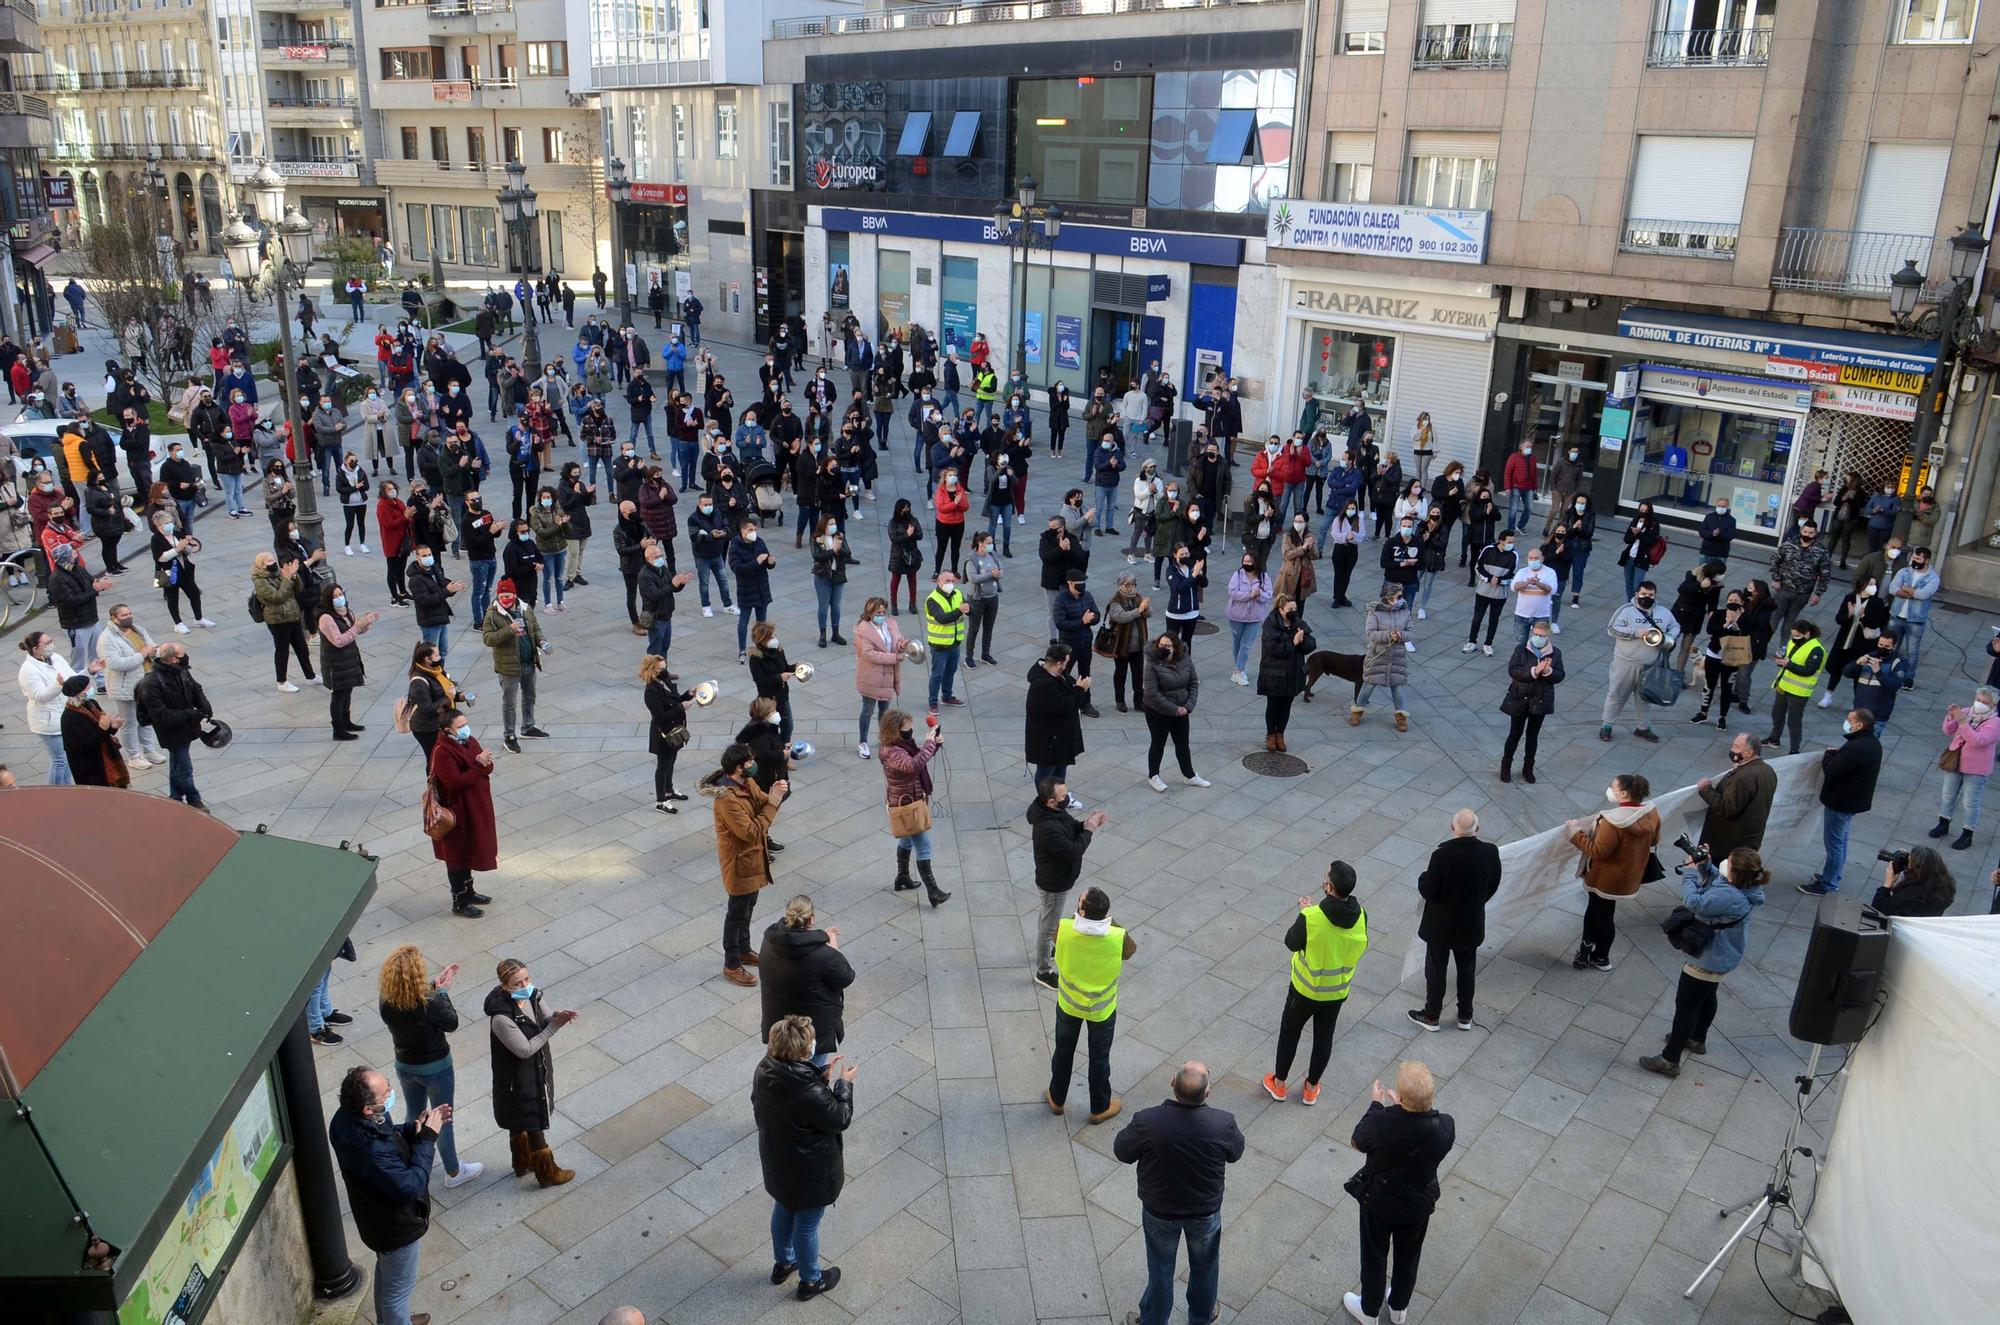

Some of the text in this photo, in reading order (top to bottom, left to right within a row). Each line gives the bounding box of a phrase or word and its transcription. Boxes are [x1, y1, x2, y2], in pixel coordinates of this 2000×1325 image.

[832, 155, 876, 184] Europea
[50, 181, 68, 195] MF
[642, 187, 664, 198] Santander
[832, 182, 849, 190] Seguros
[862, 216, 888, 229] BBVA
[1308, 207, 1360, 227] FUNDACIÓN
[1363, 212, 1400, 230] GALEGA
[1131, 237, 1168, 253] BBVA
[1293, 229, 1413, 253] CONTRA O NARCOTRÁFICO
[1419, 240, 1478, 253] 900 102 300
[1150, 284, 1166, 292] BBVA
[1307, 290, 1487, 328] RAPARIZ JOYERIA
[1145, 338, 1158, 346] BBVA
[1628, 327, 1672, 342] ADMON.
[1676, 332, 1692, 344] DE
[1694, 334, 1751, 351] LOTERIAS
[1773, 344, 1781, 355] 1
[1856, 356, 1888, 367] Apuestas
[1889, 360, 1900, 368] del
[1901, 362, 1926, 372] Estado
[1808, 369, 1837, 381] Santi
[1843, 365, 1919, 389] COMPRO ORO
[1712, 383, 1746, 395] Apuestas
[1748, 385, 1760, 396] del
[1762, 390, 1789, 400] Estado
